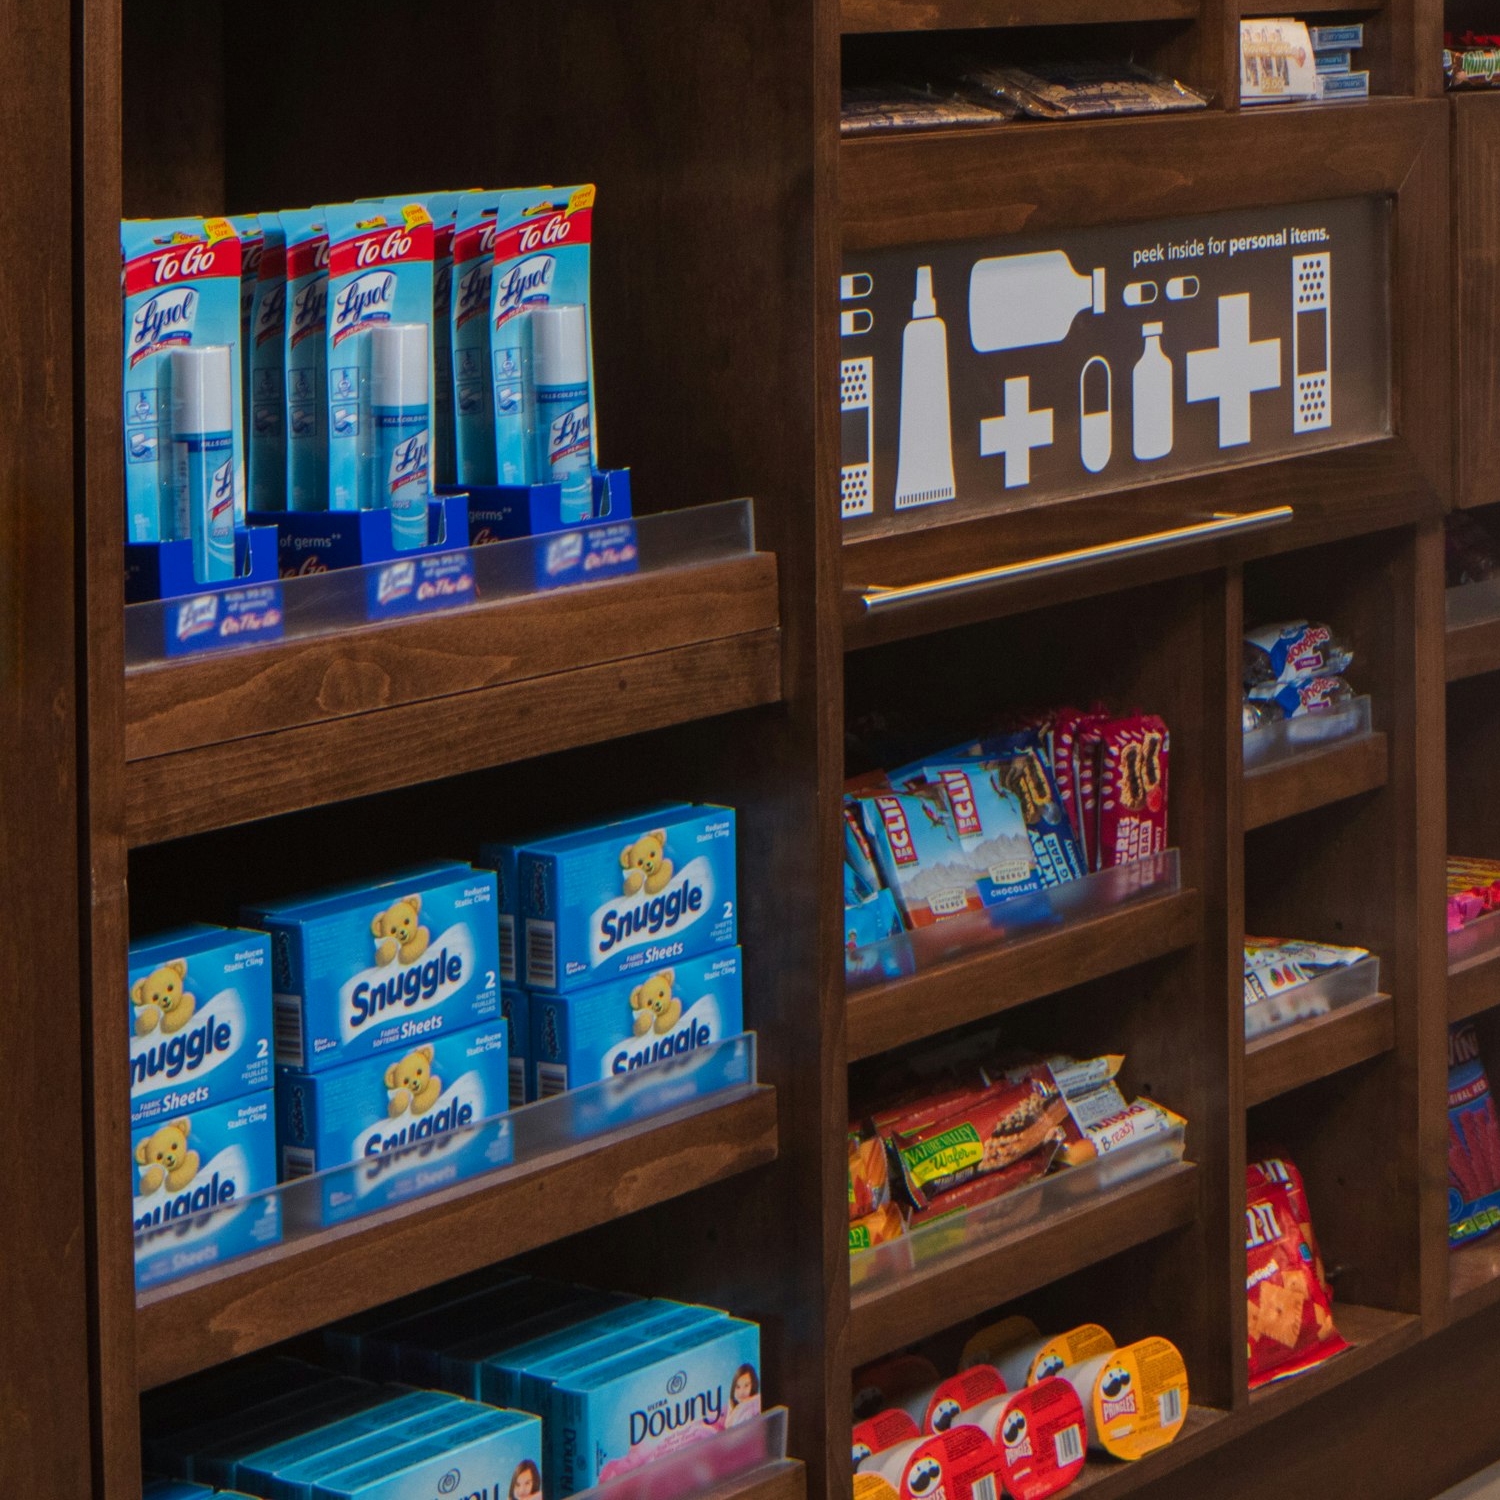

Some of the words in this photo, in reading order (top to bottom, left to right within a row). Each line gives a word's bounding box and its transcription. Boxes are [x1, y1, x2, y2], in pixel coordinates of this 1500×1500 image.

[354, 237, 380, 268] To
[380, 229, 413, 260] Go
[518, 224, 541, 252] To
[542, 217, 572, 245] Go
[1133, 243, 1165, 269] peek
[1168, 238, 1205, 261] inside
[1207, 236, 1226, 255] for
[1229, 228, 1288, 257] personal
[1290, 227, 1331, 245] items.
[152, 251, 178, 284] To
[180, 245, 216, 276] Go
[500, 258, 552, 308] Lysol
[336, 274, 393, 325] Lysol
[134, 291, 194, 344] Lysol
[945, 770, 974, 819] CLIF
[704, 821, 730, 834] Reduces
[880, 796, 909, 849] CLIF
[463, 884, 490, 898] Reduces
[990, 882, 1038, 897] CHOCOLATE
[995, 870, 1028, 884] ENERGY
[598, 878, 703, 953] Snuggle
[722, 901, 734, 919] 2
[223, 960, 244, 974] Static
[234, 947, 264, 962] Reduces
[644, 940, 684, 966] Sheets
[349, 946, 463, 1028] Snuggle
[484, 970, 497, 990] 2
[400, 1013, 444, 1041] Sheets
[475, 1032, 502, 1046] Reduces
[130, 1014, 232, 1088] nuggle
[256, 1038, 269, 1059] 2
[372, 1034, 400, 1049] SOFTENER
[161, 1086, 209, 1114] Sheets
[237, 1103, 267, 1118] Reduces
[1088, 1104, 1146, 1133] nutella
[905, 1138, 940, 1164] NATURE
[939, 1128, 975, 1149] VALLEY
[1101, 1121, 1134, 1151] B-ready
[629, 1385, 724, 1447] Downy
[1103, 1395, 1137, 1423] PRINGLES
[1005, 1443, 1033, 1466] PRINGLES
